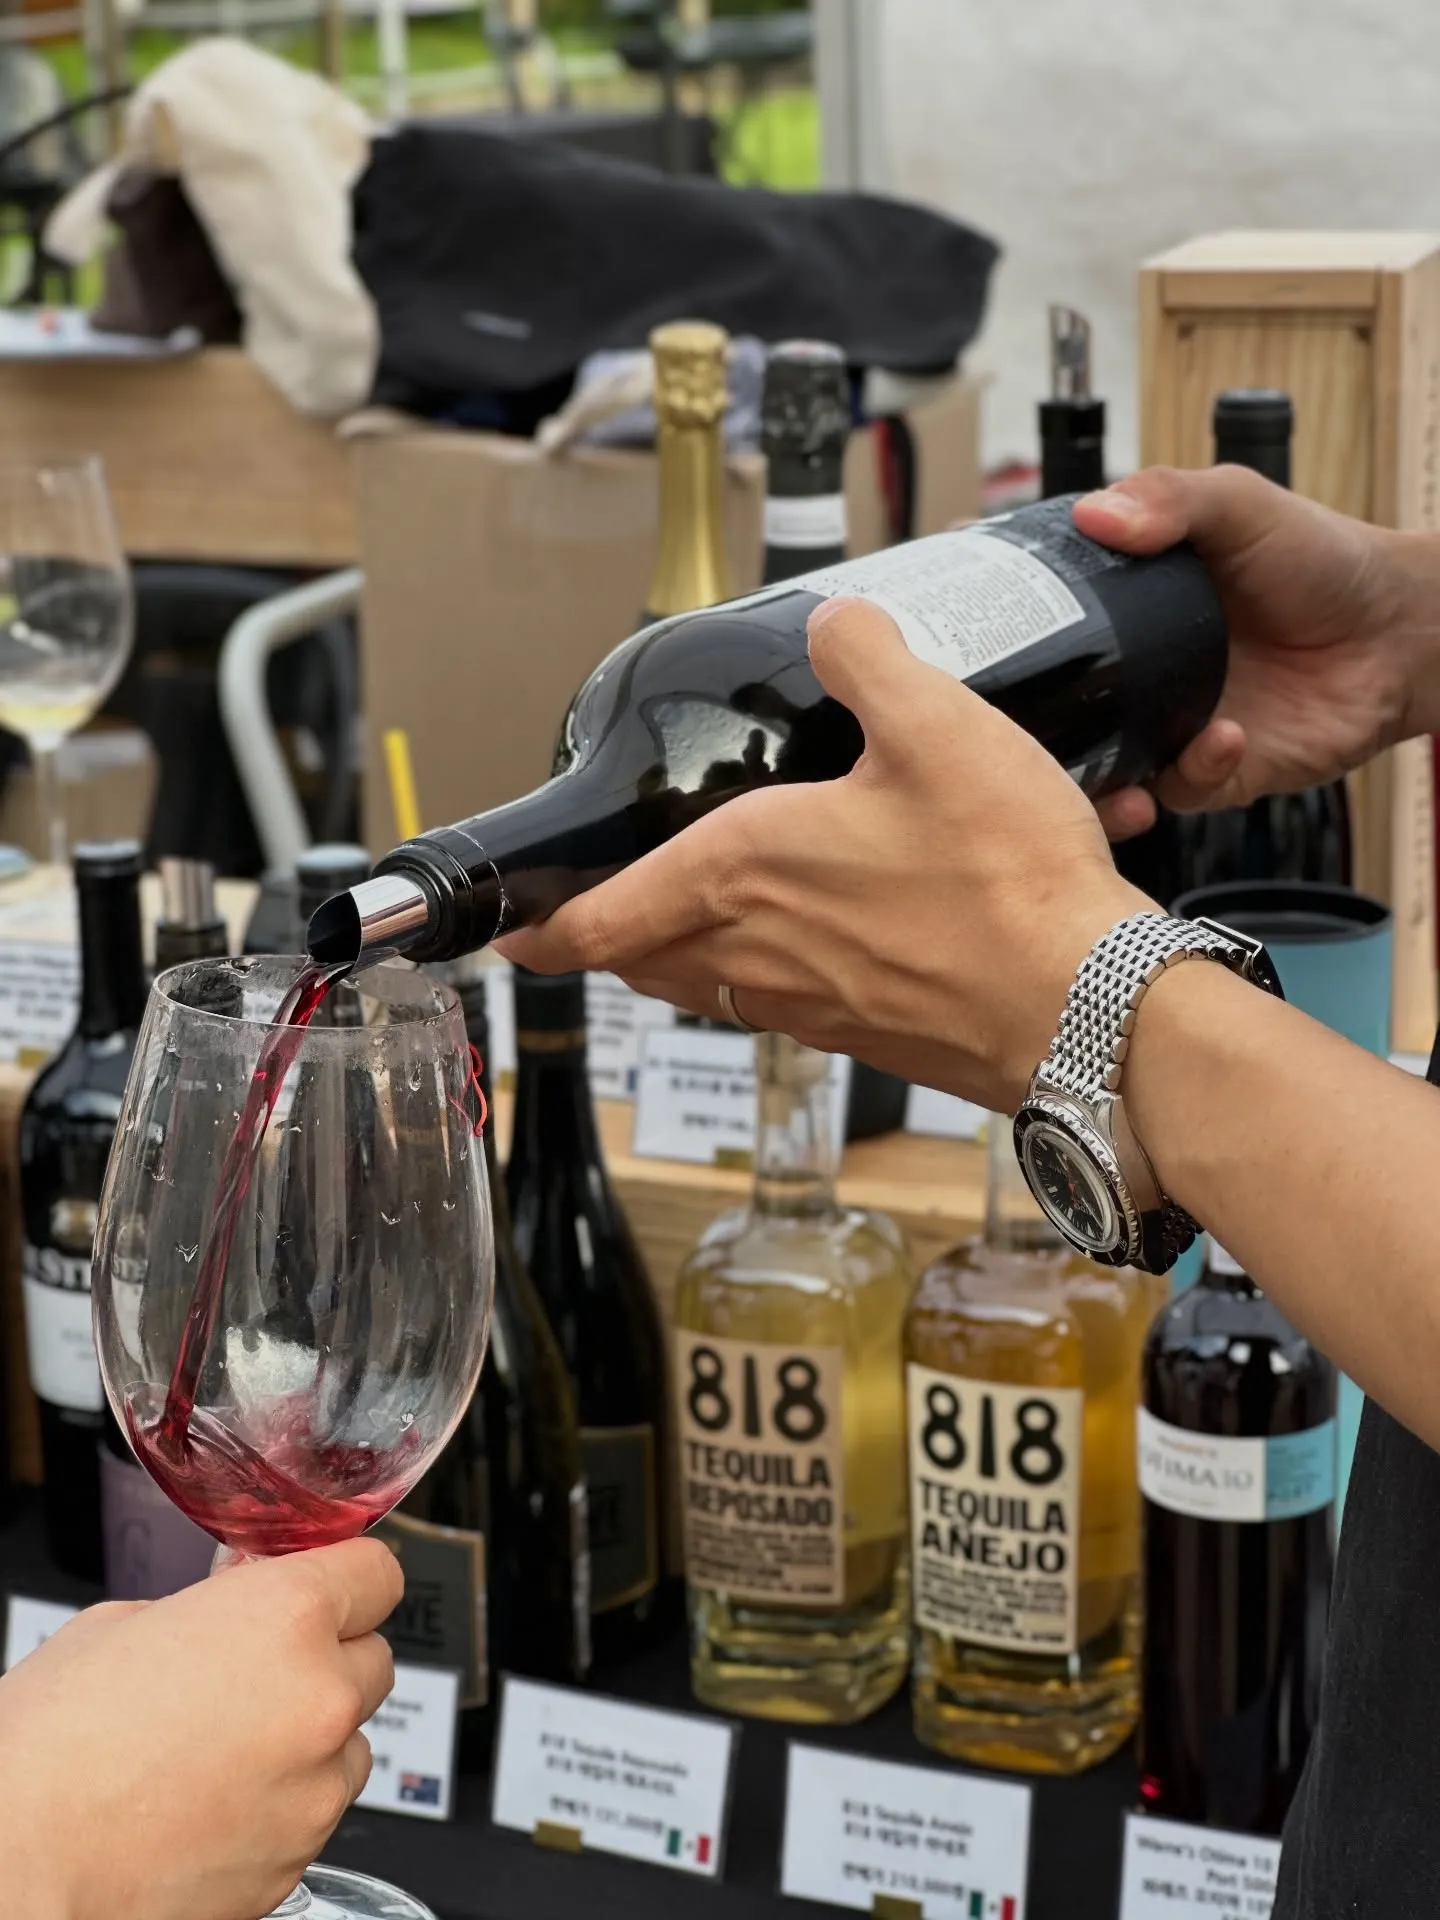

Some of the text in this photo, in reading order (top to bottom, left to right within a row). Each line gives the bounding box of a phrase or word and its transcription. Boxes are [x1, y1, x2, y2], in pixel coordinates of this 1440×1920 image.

[687, 1346, 827, 1442] 818
[921, 1383, 1065, 1485] 818
[686, 1440, 832, 1490] TEQUILA
[687, 1481, 834, 1528] REPOSADO
[919, 1477, 1068, 1535] TEQUILA
[920, 1521, 1067, 1575] AÑEJO
